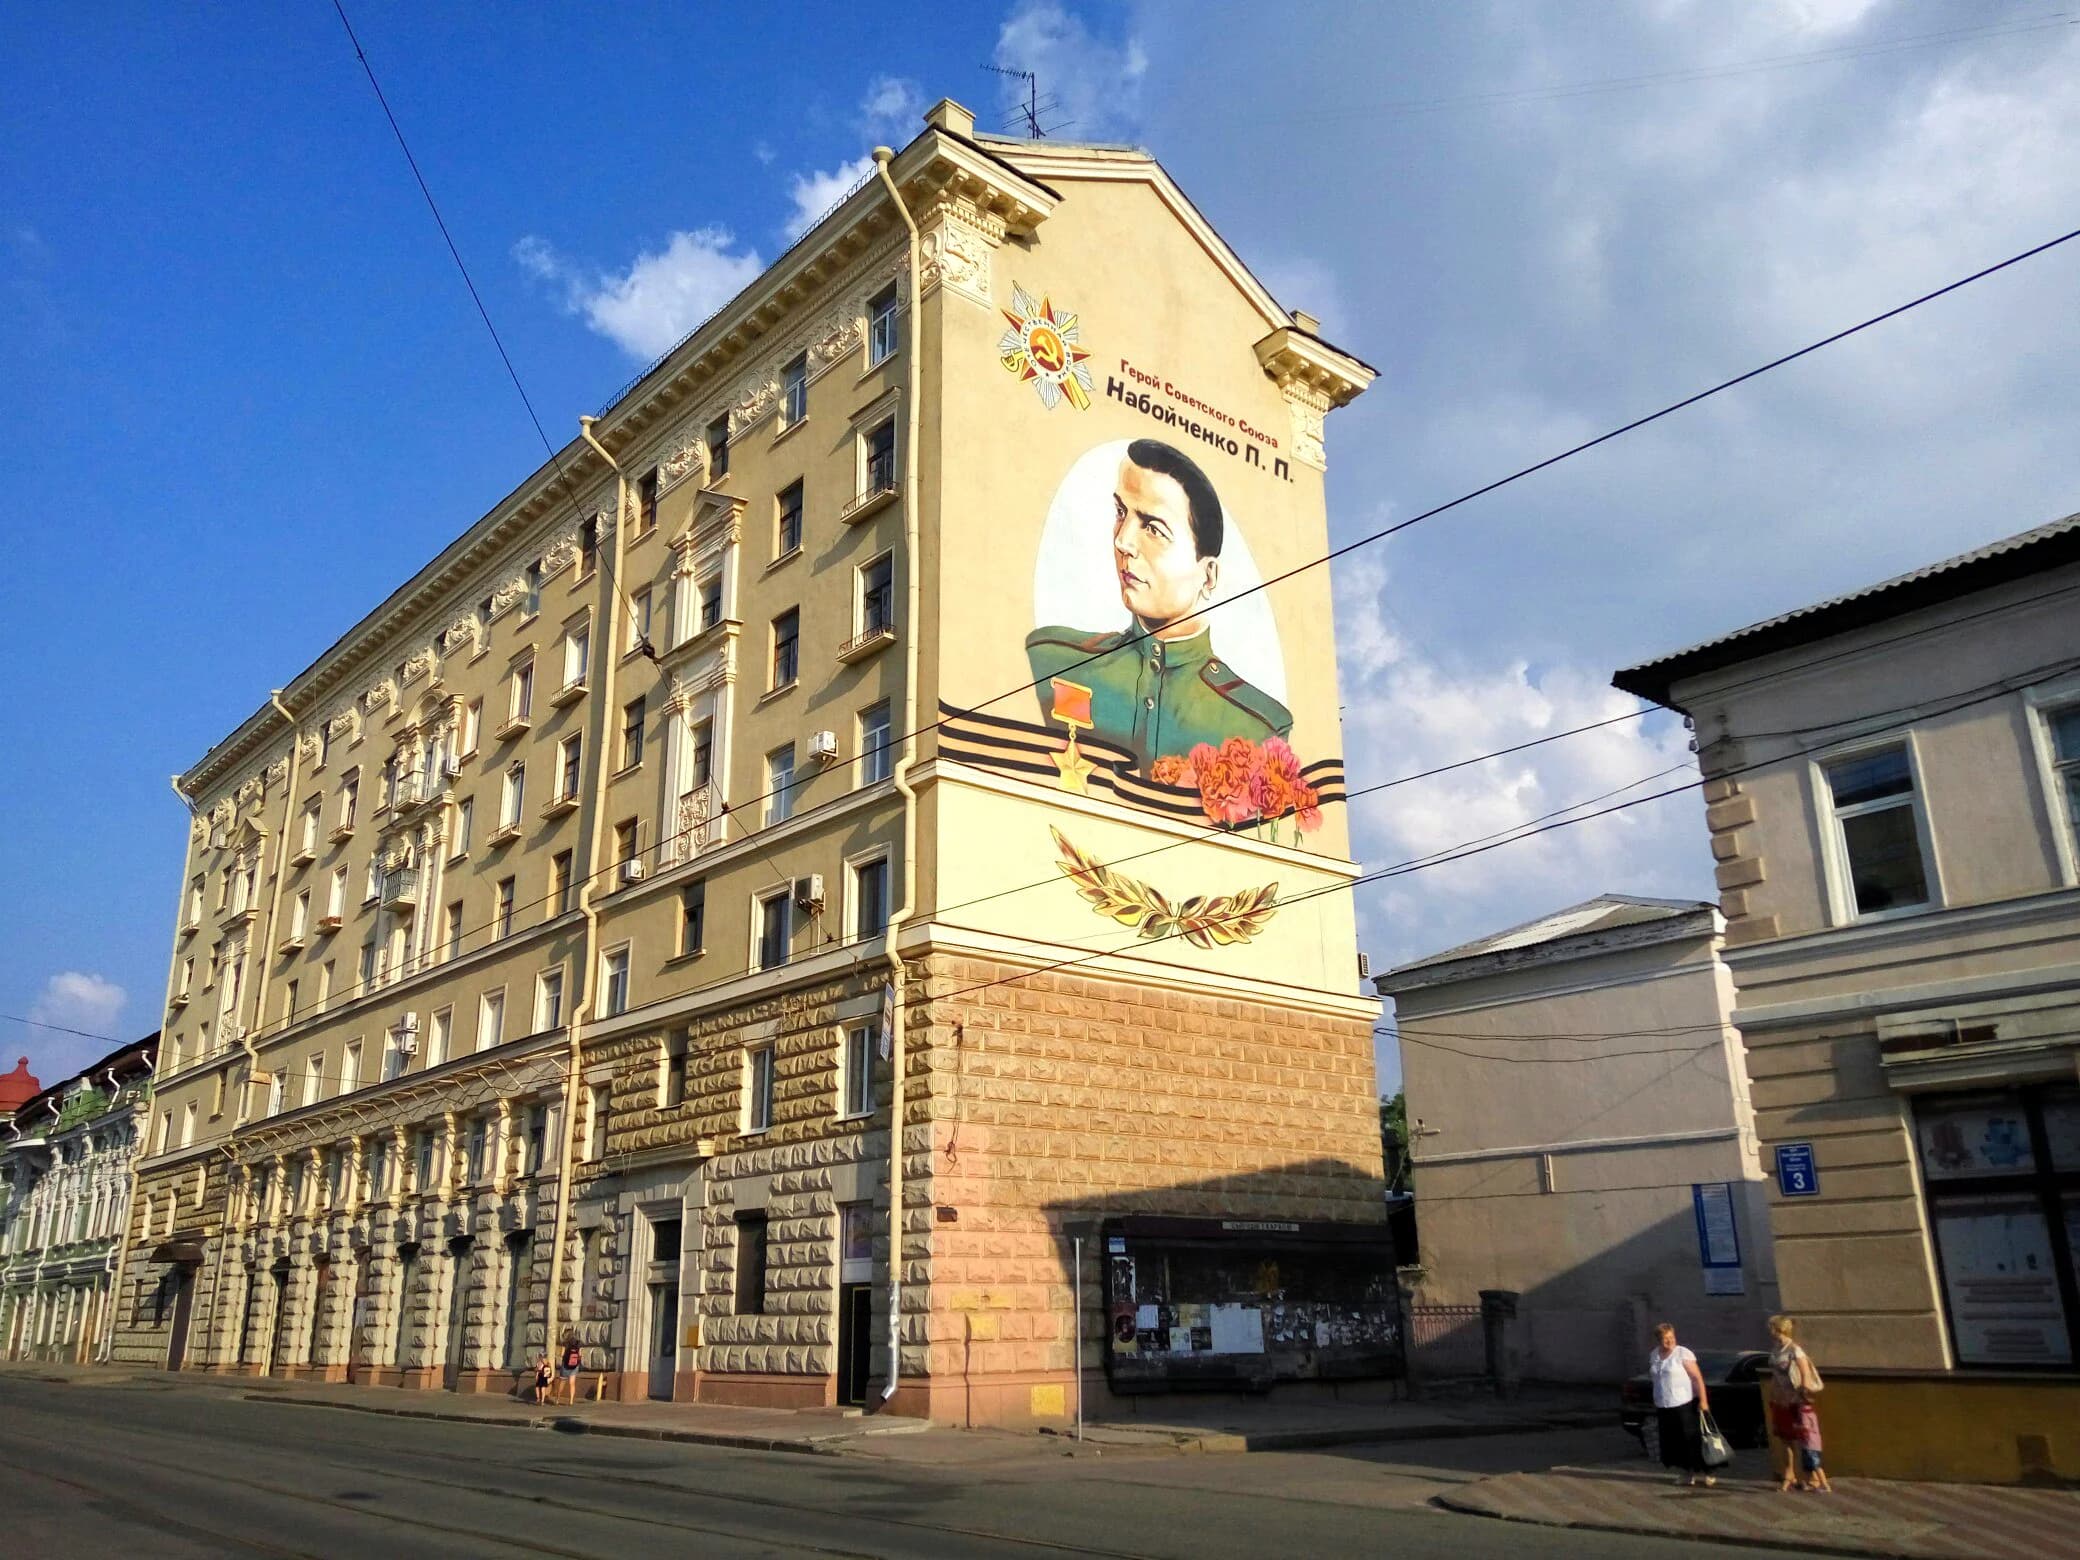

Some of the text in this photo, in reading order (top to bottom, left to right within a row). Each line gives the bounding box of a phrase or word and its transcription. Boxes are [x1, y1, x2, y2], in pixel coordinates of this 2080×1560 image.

[1106, 375, 1294, 484] Набойченко П. П.
[1120, 358, 1278, 449] Герой Советского Союза
[1793, 1172, 1805, 1190] 3
